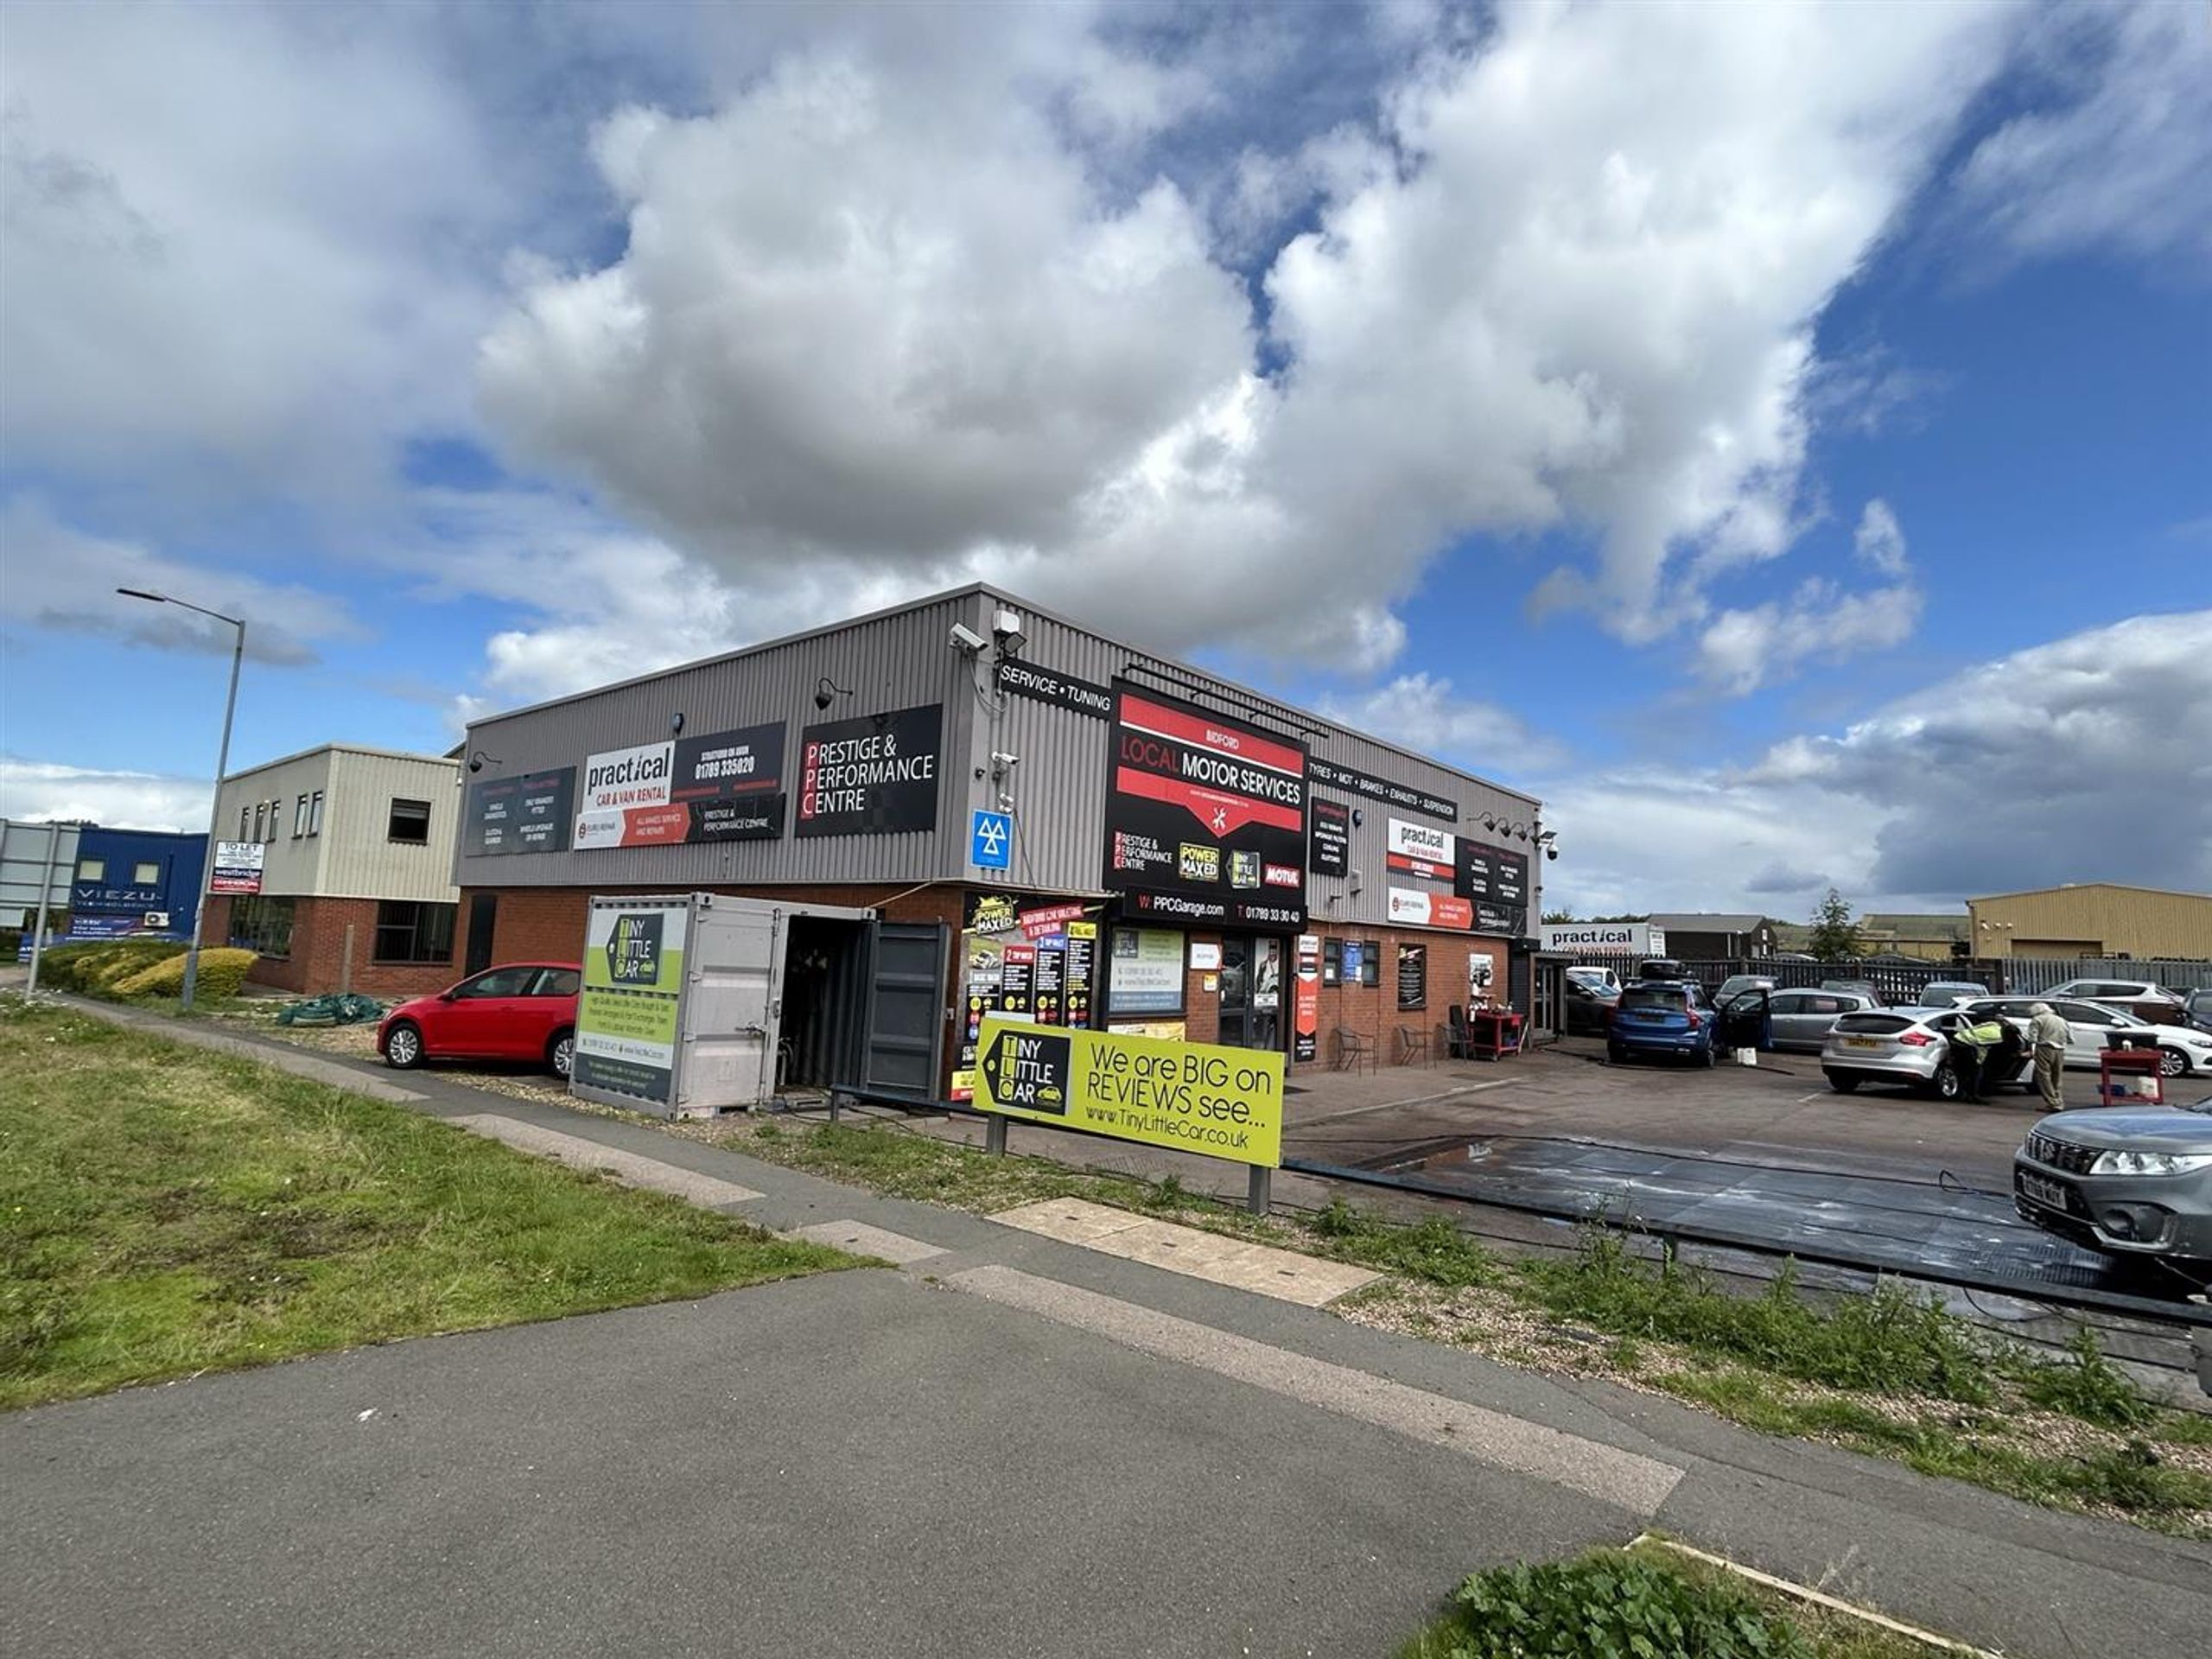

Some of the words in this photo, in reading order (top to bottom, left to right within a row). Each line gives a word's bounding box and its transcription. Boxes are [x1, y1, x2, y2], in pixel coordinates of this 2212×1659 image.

[1001, 664, 1058, 695] SERVICE
[1067, 685, 1111, 711] TUNING
[1205, 729, 1240, 750] BIDFORD
[806, 735, 880, 767] PRESTIGE
[883, 734, 897, 757] &
[588, 747, 671, 795] practical
[805, 754, 934, 791] PERFORMANCE
[1120, 734, 1179, 772] LOCAL
[1182, 752, 1239, 789] MOTOR
[1241, 769, 1301, 804] SERVICES
[1309, 762, 1332, 779] TYRES
[1338, 772, 1353, 785] MOT
[1359, 779, 1384, 795] BRAKES
[596, 792, 613, 806] CAR
[619, 790, 635, 804] VAN
[637, 785, 666, 802] RENTAL
[802, 788, 865, 815] CENTRE
[1115, 831, 1151, 849] PRESTIGE
[1401, 826, 1444, 849] practical
[1114, 856, 1145, 871] CENTRE
[1115, 845, 1173, 863] PERFORMANCE
[1181, 847, 1217, 863] POWER
[1180, 860, 1217, 877] MAXED
[1266, 867, 1300, 887] MOTUL
[78, 888, 156, 900] VIEZU
[977, 908, 1011, 922] POWER
[1154, 896, 1224, 917] PPCGarage.com
[620, 918, 645, 938] TINY
[977, 916, 1014, 931] MAXED
[616, 938, 652, 958] LITTLE
[1552, 929, 1632, 946] practical
[614, 959, 639, 978] CAR
[1004, 1036, 1043, 1060] TINY
[1001, 1058, 1054, 1084] LITTLE
[1090, 1043, 1128, 1073] We
[1134, 1058, 1177, 1080] are
[1183, 1054, 1229, 1088] BIG
[1236, 1068, 1271, 1095] on
[999, 1077, 1035, 1103] CAR
[1087, 1071, 1192, 1115] REVIEWS
[1198, 1095, 1266, 1128] see...
[1085, 1104, 1249, 1150] www.TinyLittleCar.co.uk
